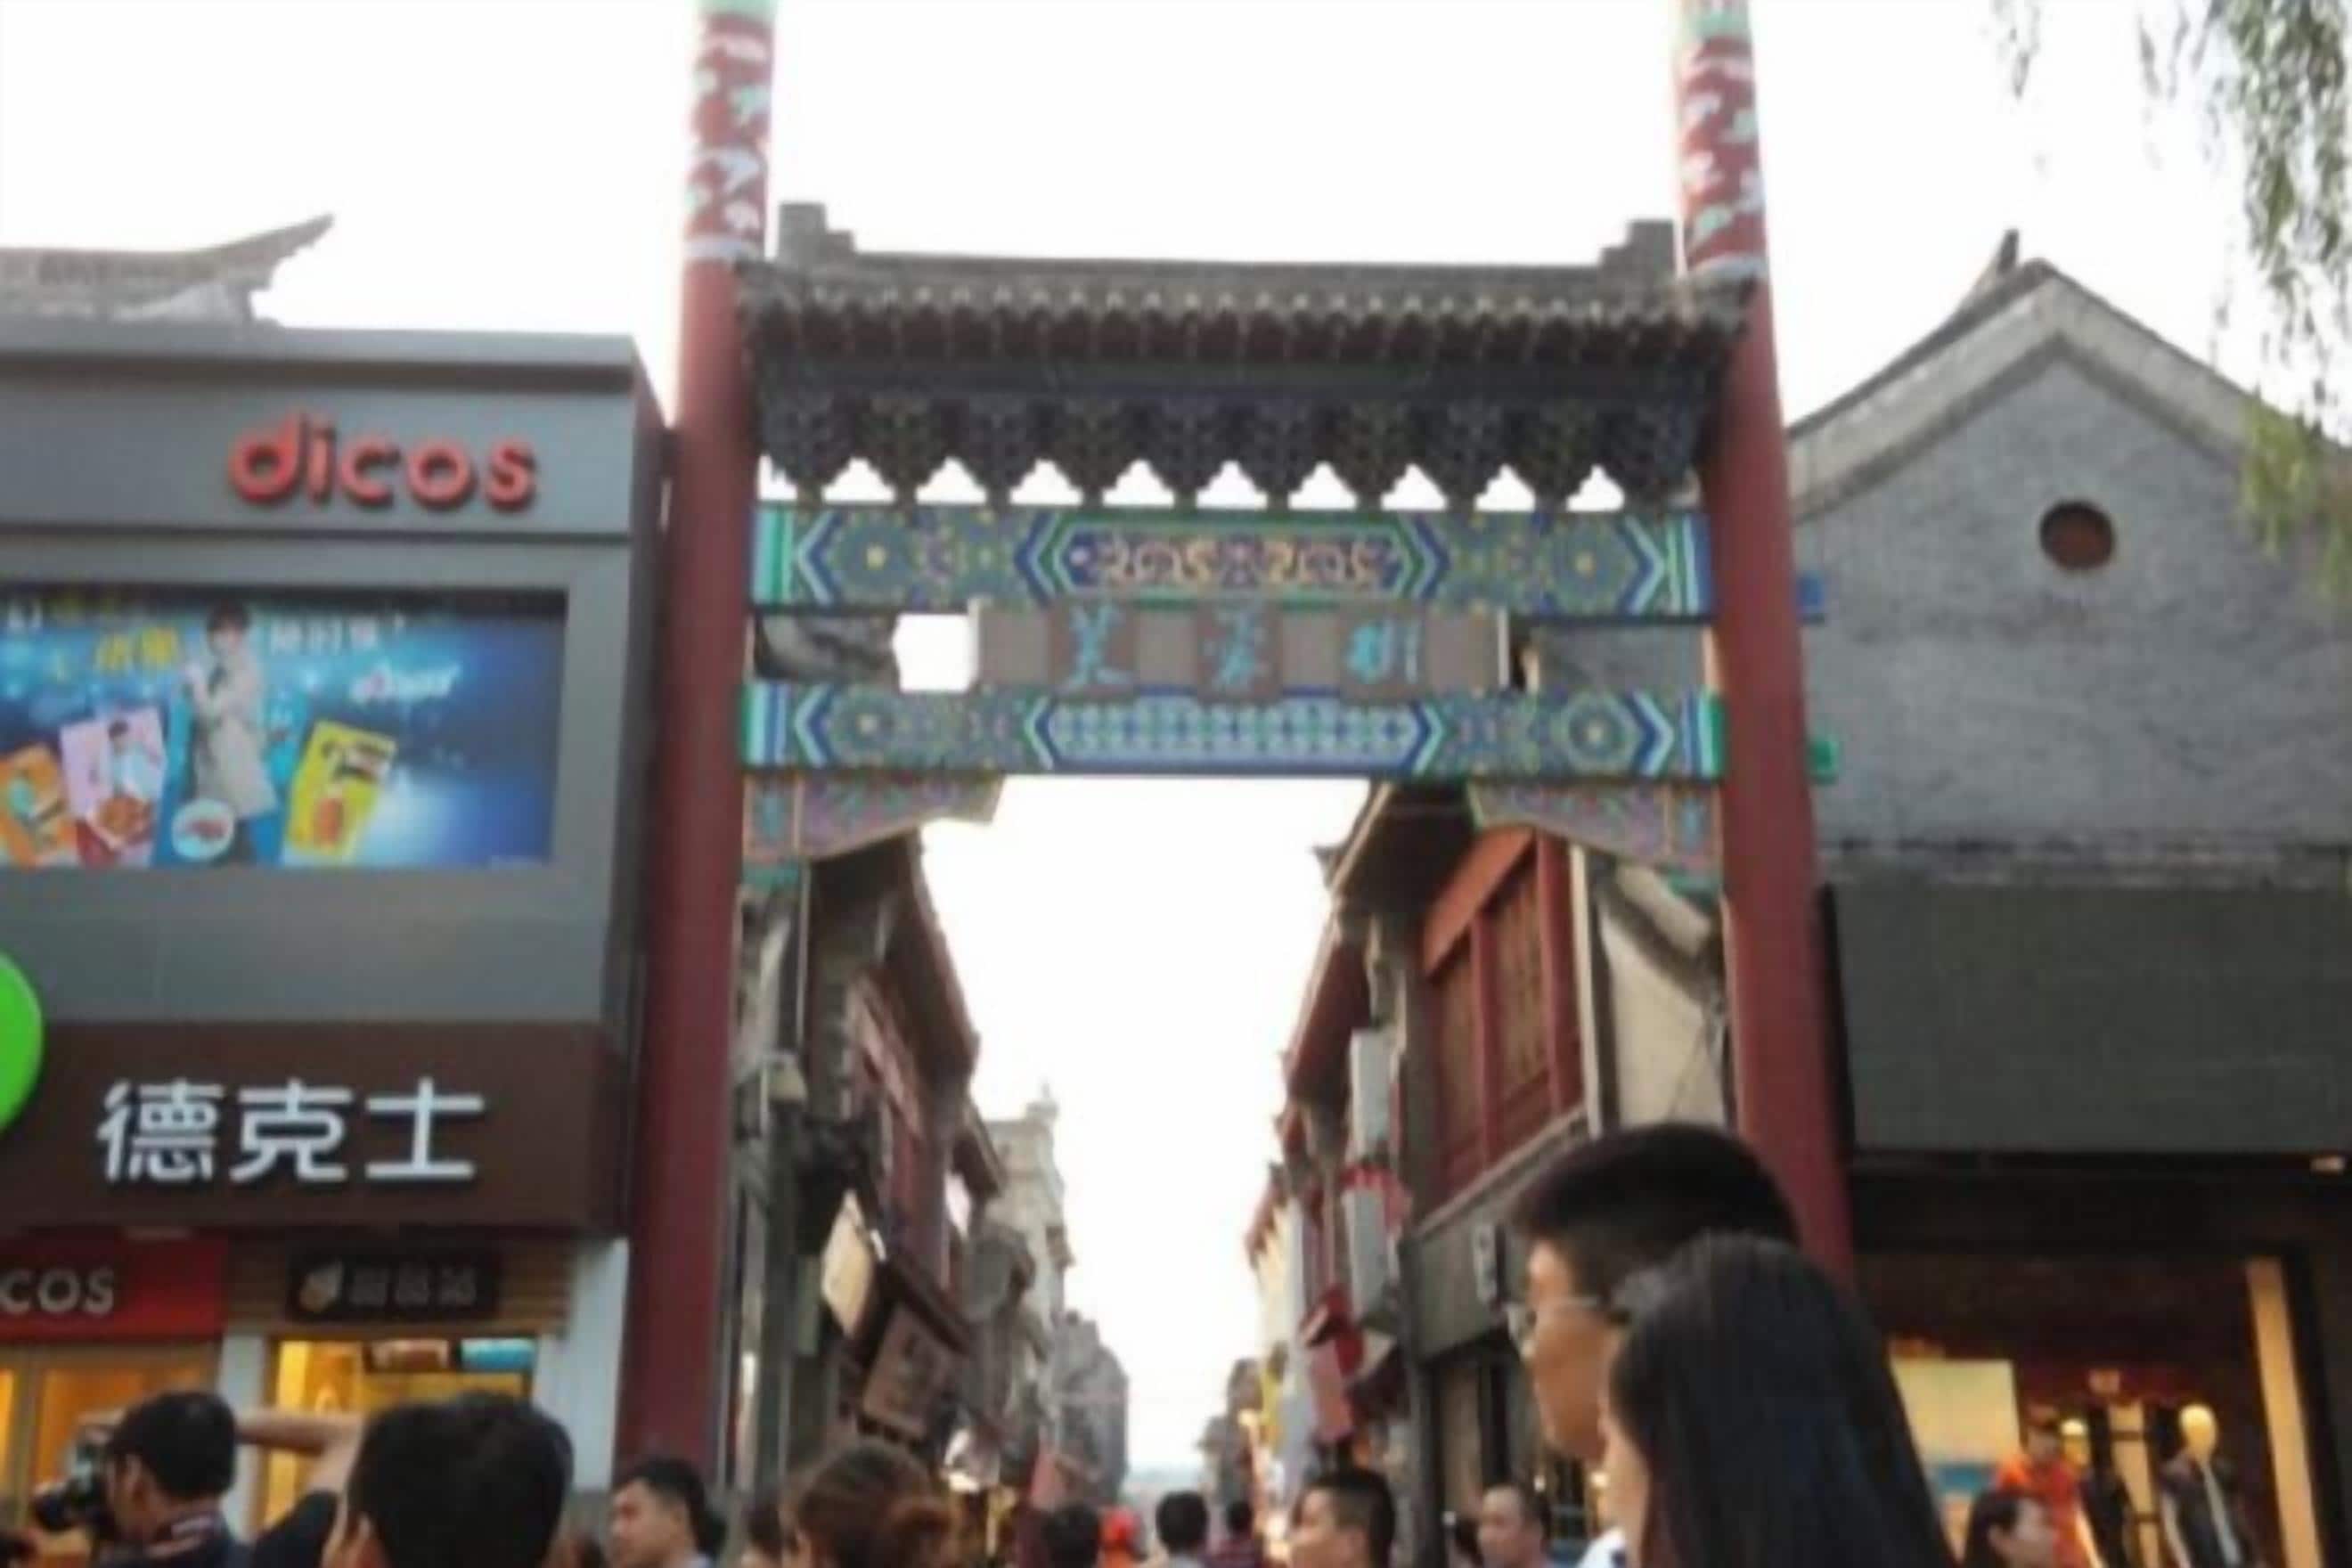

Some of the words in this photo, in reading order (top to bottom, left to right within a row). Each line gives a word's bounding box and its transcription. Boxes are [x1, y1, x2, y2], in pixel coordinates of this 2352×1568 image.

[228, 409, 536, 510] dicos
[96, 1077, 486, 1183] 德克士
